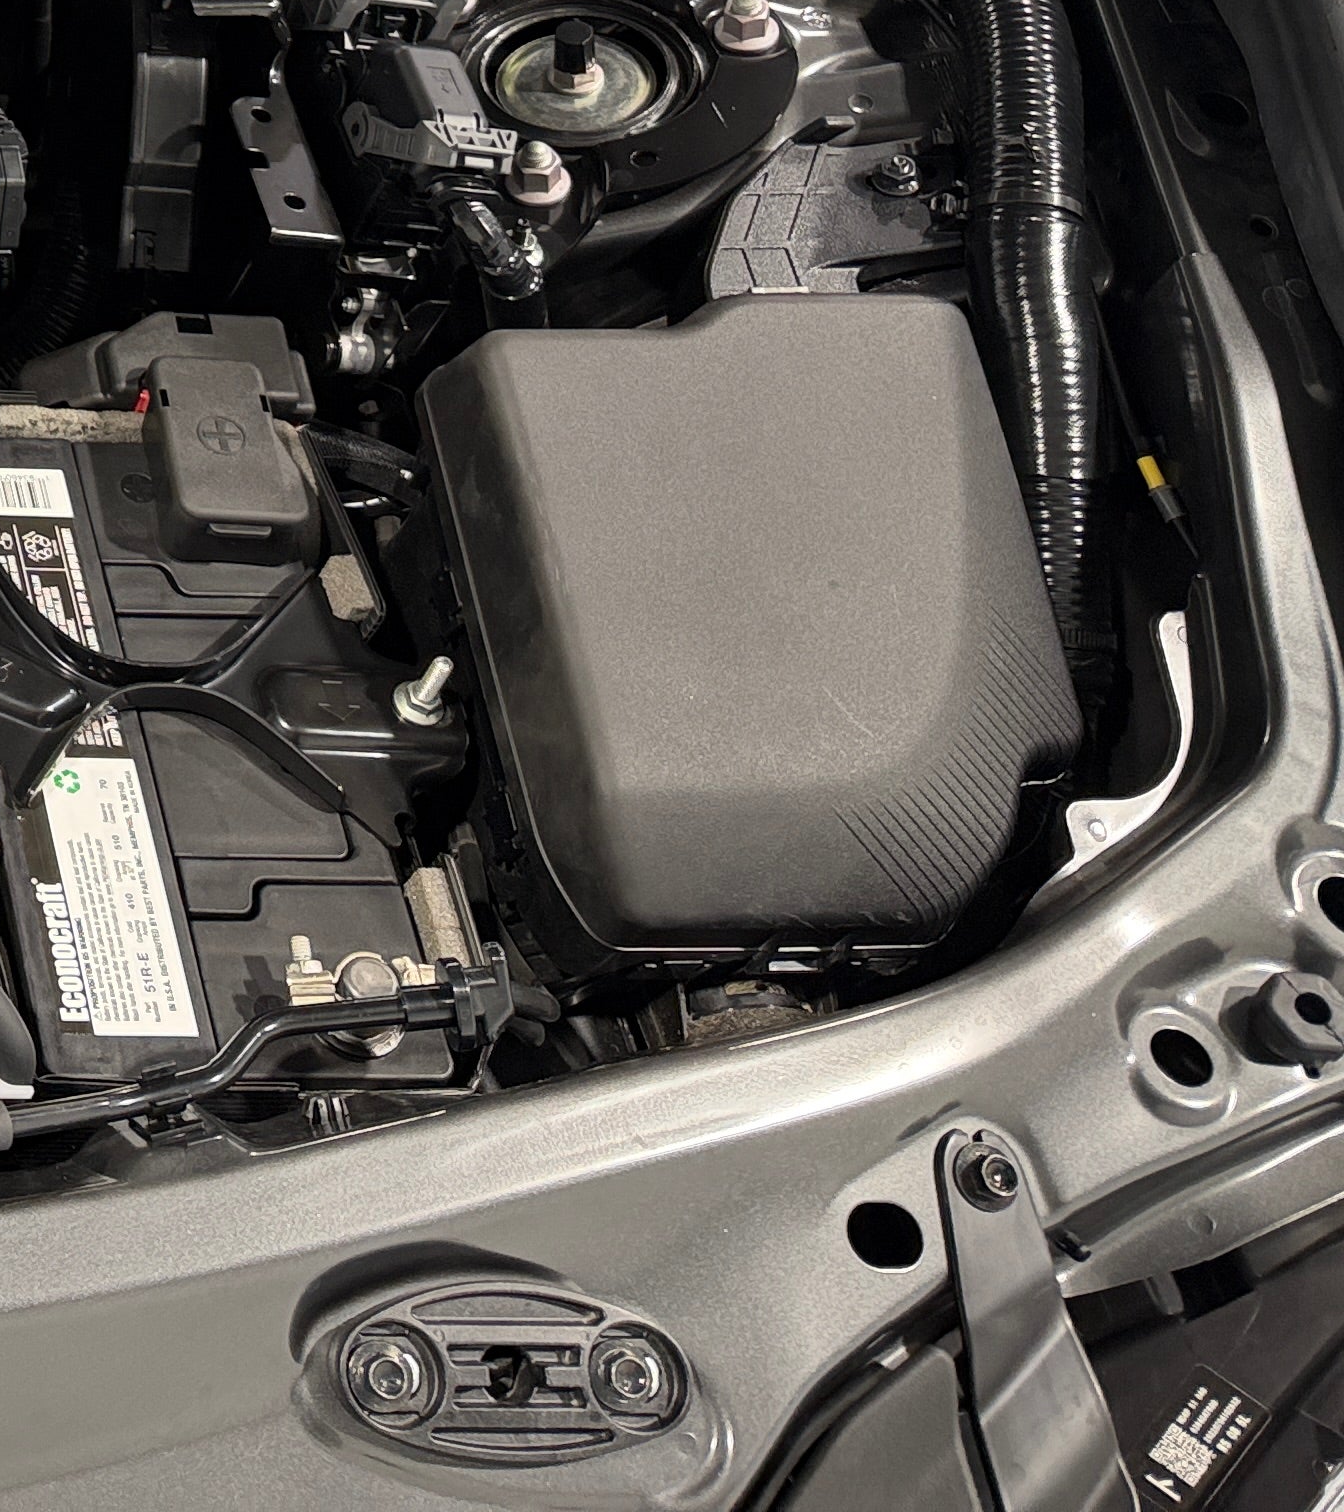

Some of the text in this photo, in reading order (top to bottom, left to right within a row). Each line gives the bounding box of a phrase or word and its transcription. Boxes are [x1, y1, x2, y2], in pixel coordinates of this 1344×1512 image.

[98, 779, 108, 788] 70
[35, 882, 90, 1022] Econocraft
[136, 952, 156, 992] 51R-E
